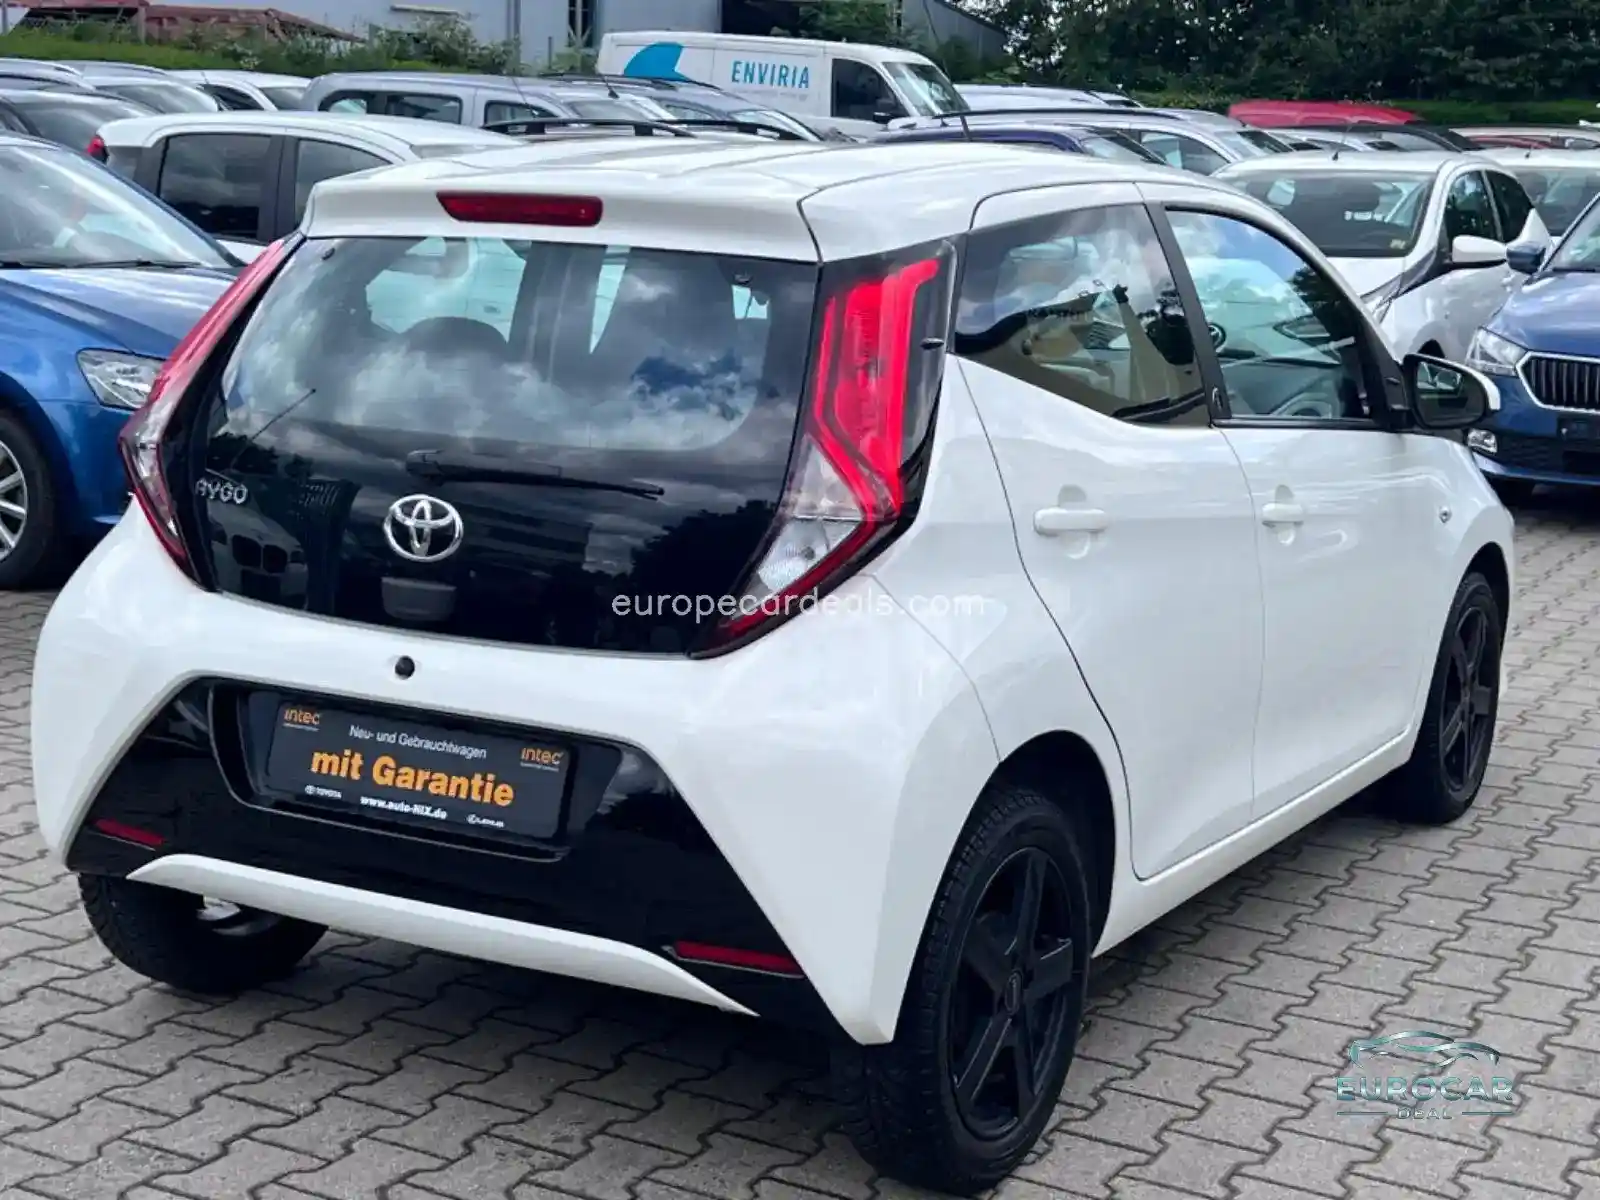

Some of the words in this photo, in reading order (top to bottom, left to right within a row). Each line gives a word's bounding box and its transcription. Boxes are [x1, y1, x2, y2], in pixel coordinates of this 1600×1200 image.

[731, 60, 809, 89] ENVIRIA
[195, 478, 248, 504] AYGO
[284, 707, 320, 725] intec
[349, 724, 374, 739] Neu-
[376, 731, 397, 743] und
[398, 732, 487, 759] Gebrauchtwagen
[521, 747, 563, 765] intec
[310, 748, 364, 780] mit
[372, 754, 514, 807] Garantie
